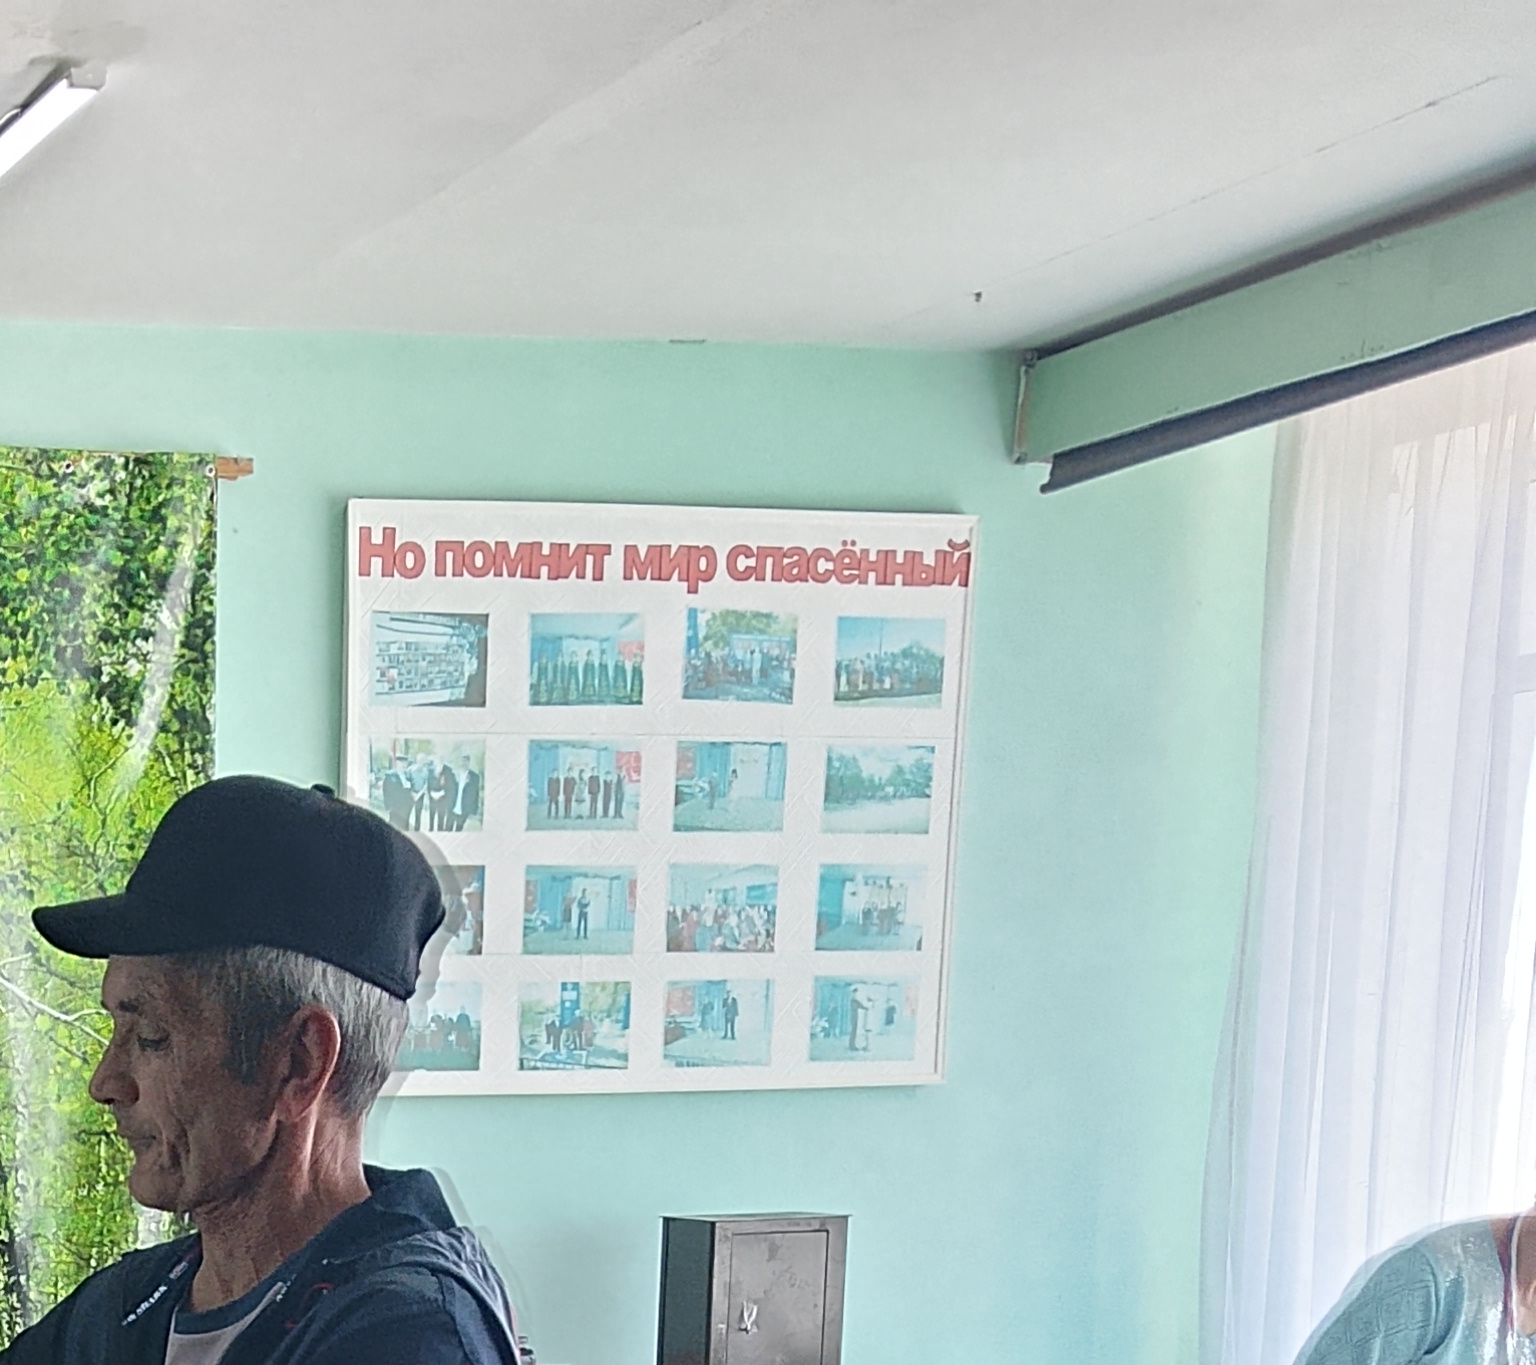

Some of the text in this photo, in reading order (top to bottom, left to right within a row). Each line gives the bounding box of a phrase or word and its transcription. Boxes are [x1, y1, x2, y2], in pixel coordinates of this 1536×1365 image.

[359, 526, 972, 593] Но помнит мир спасённый
